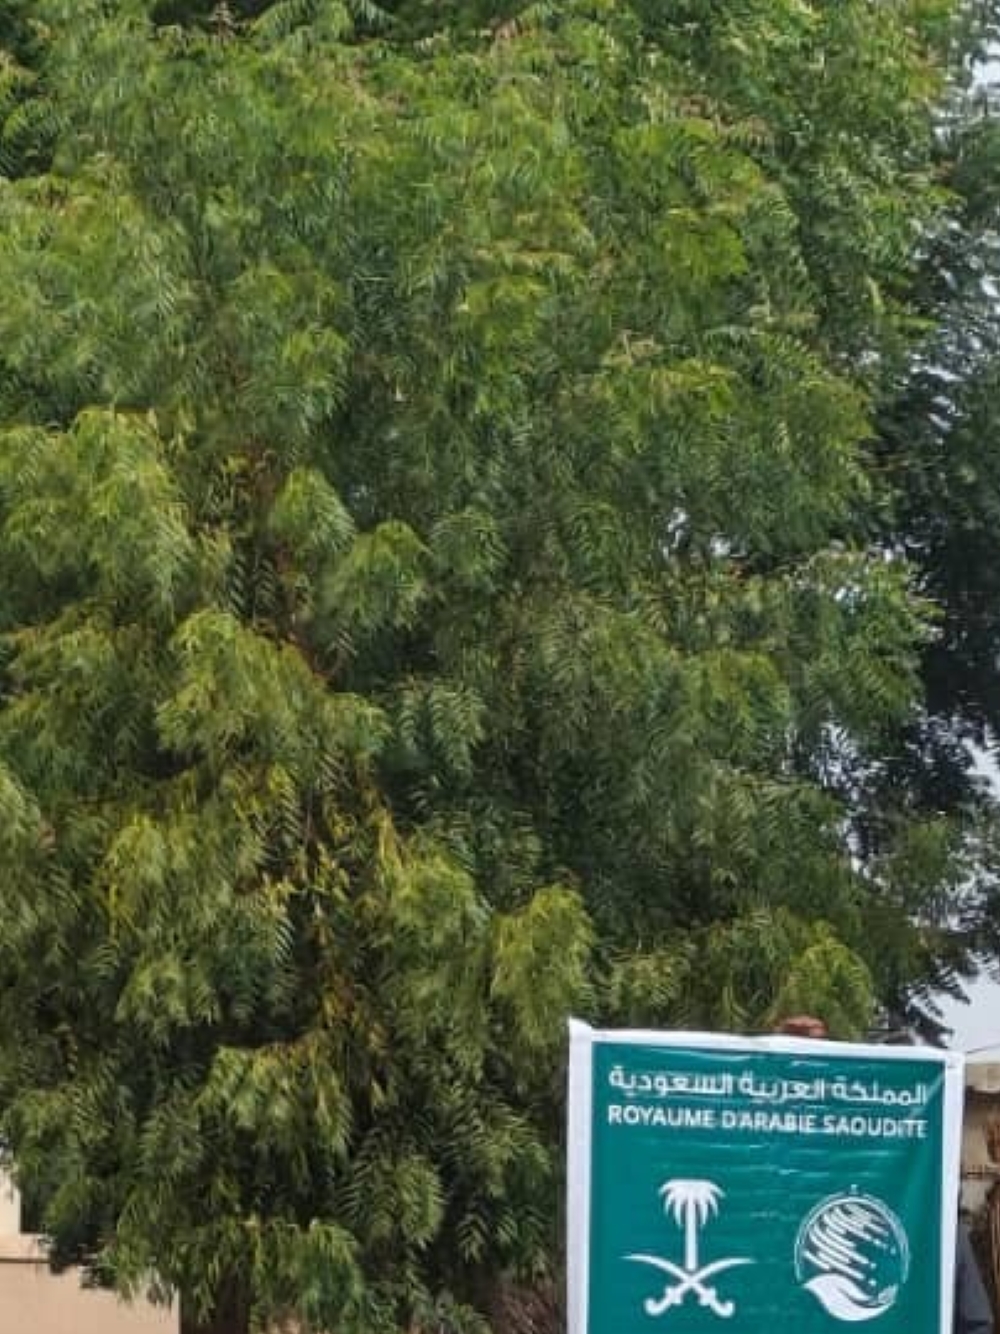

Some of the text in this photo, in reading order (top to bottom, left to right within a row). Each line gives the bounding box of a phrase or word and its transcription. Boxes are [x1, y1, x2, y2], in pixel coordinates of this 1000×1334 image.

[608, 1065, 927, 1106] المملكة العربية السعودية
[608, 1104, 716, 1128] ROYAUME
[823, 1114, 928, 1138] SAOUDITE
